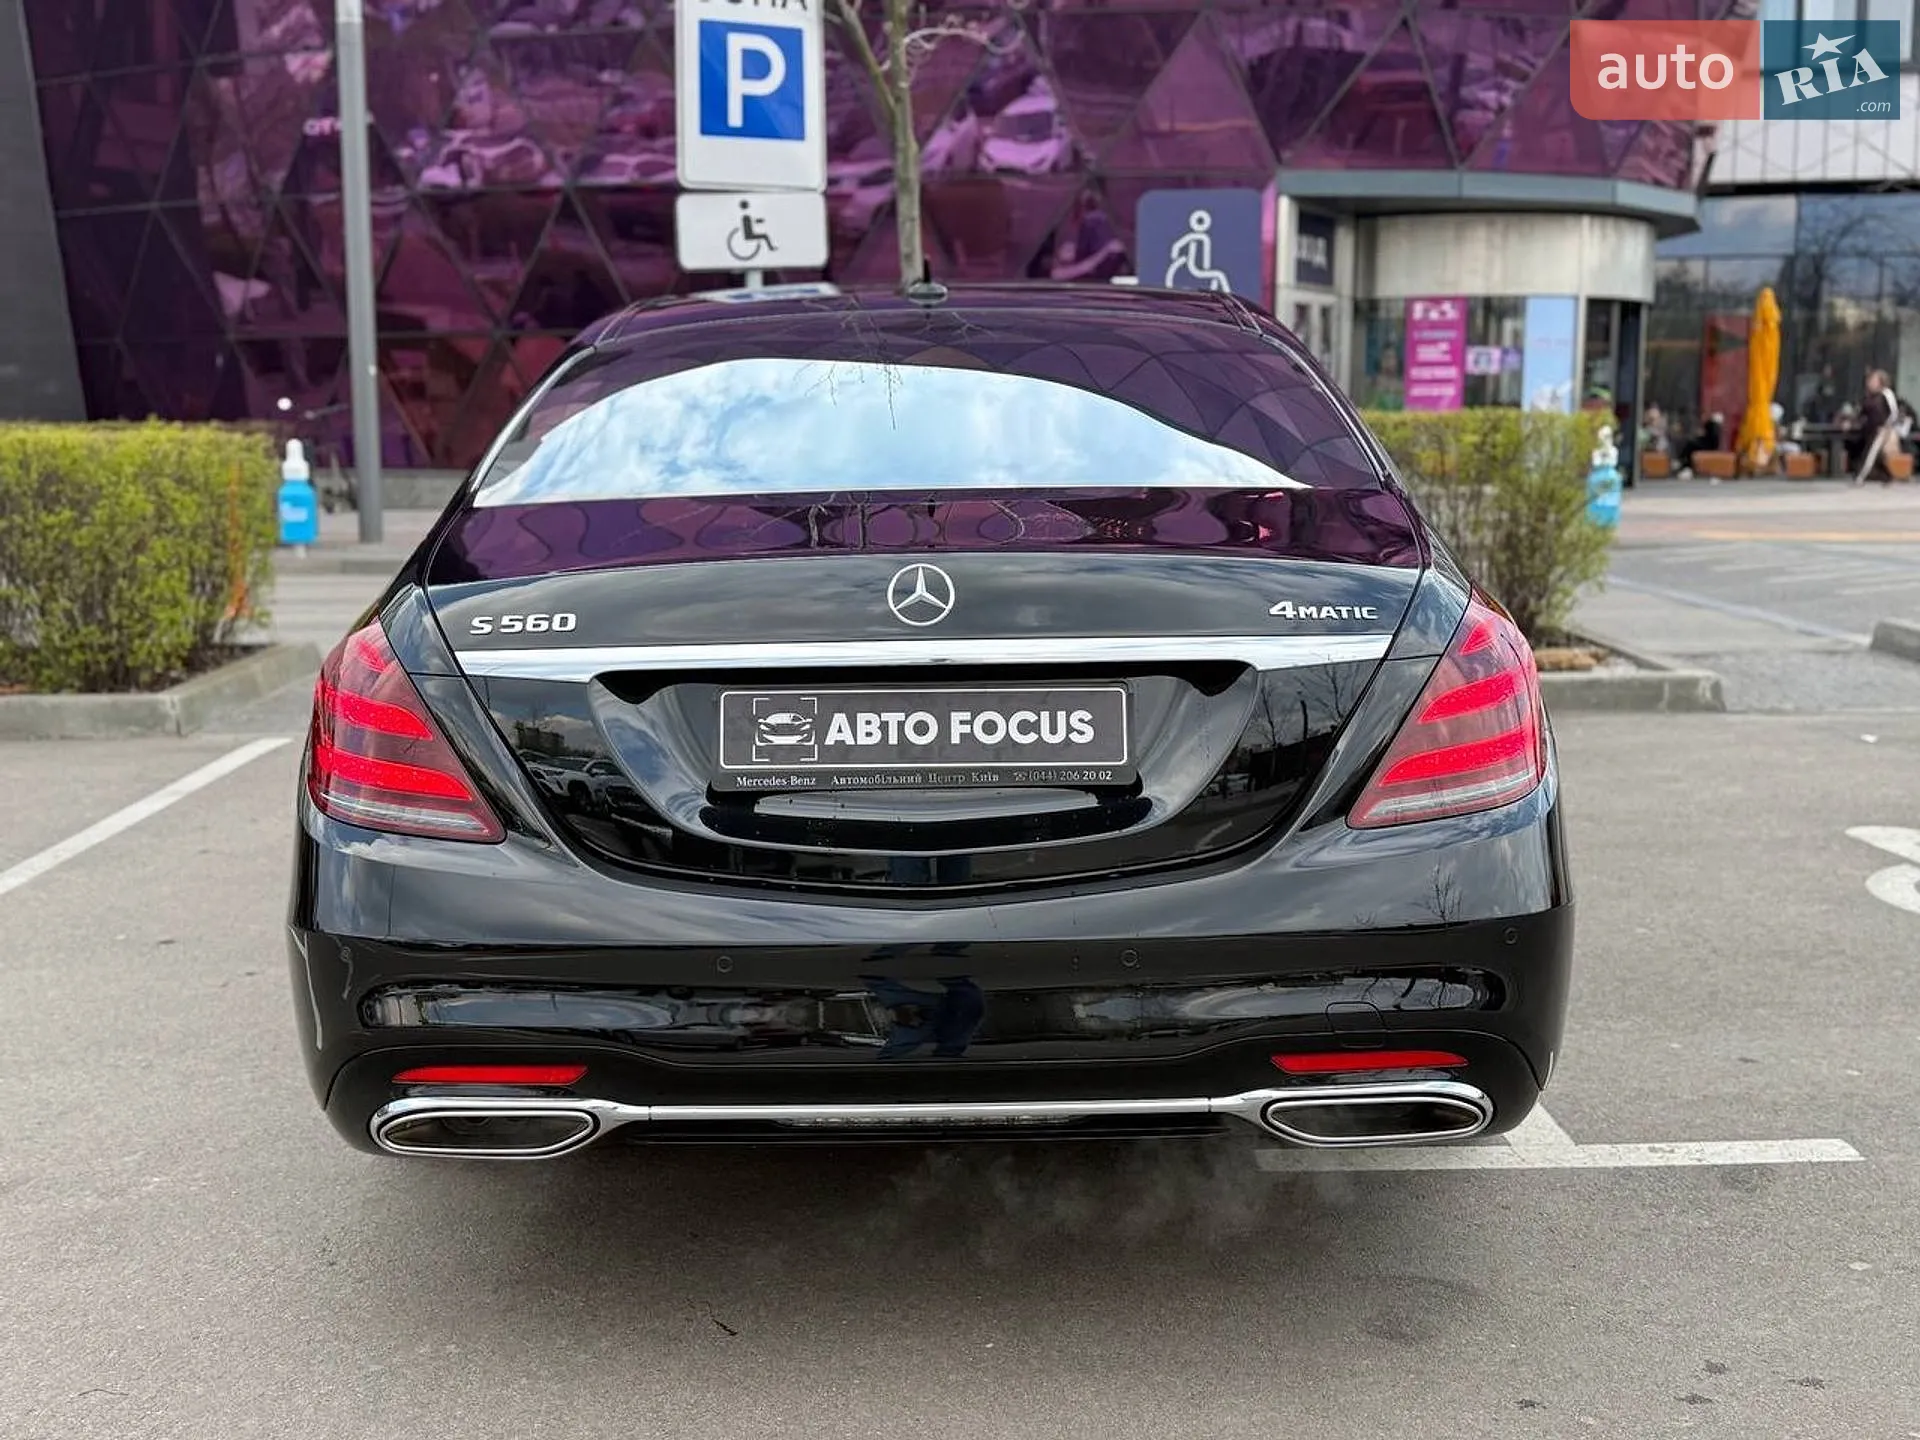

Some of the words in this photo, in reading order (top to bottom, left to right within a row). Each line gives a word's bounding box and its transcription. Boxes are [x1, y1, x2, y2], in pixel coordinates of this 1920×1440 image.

[727, 32, 786, 128] P
[1269, 600, 1379, 620] 4MATIC
[469, 616, 493, 635] S
[499, 613, 577, 634] 560
[824, 711, 939, 747] АВТО
[950, 709, 1095, 745] FOCUS
[736, 775, 817, 788] Mercedes-Benz
[831, 773, 922, 787] Автомобільний
[1082, 770, 1097, 781] 20
[1099, 769, 1113, 781] 02
